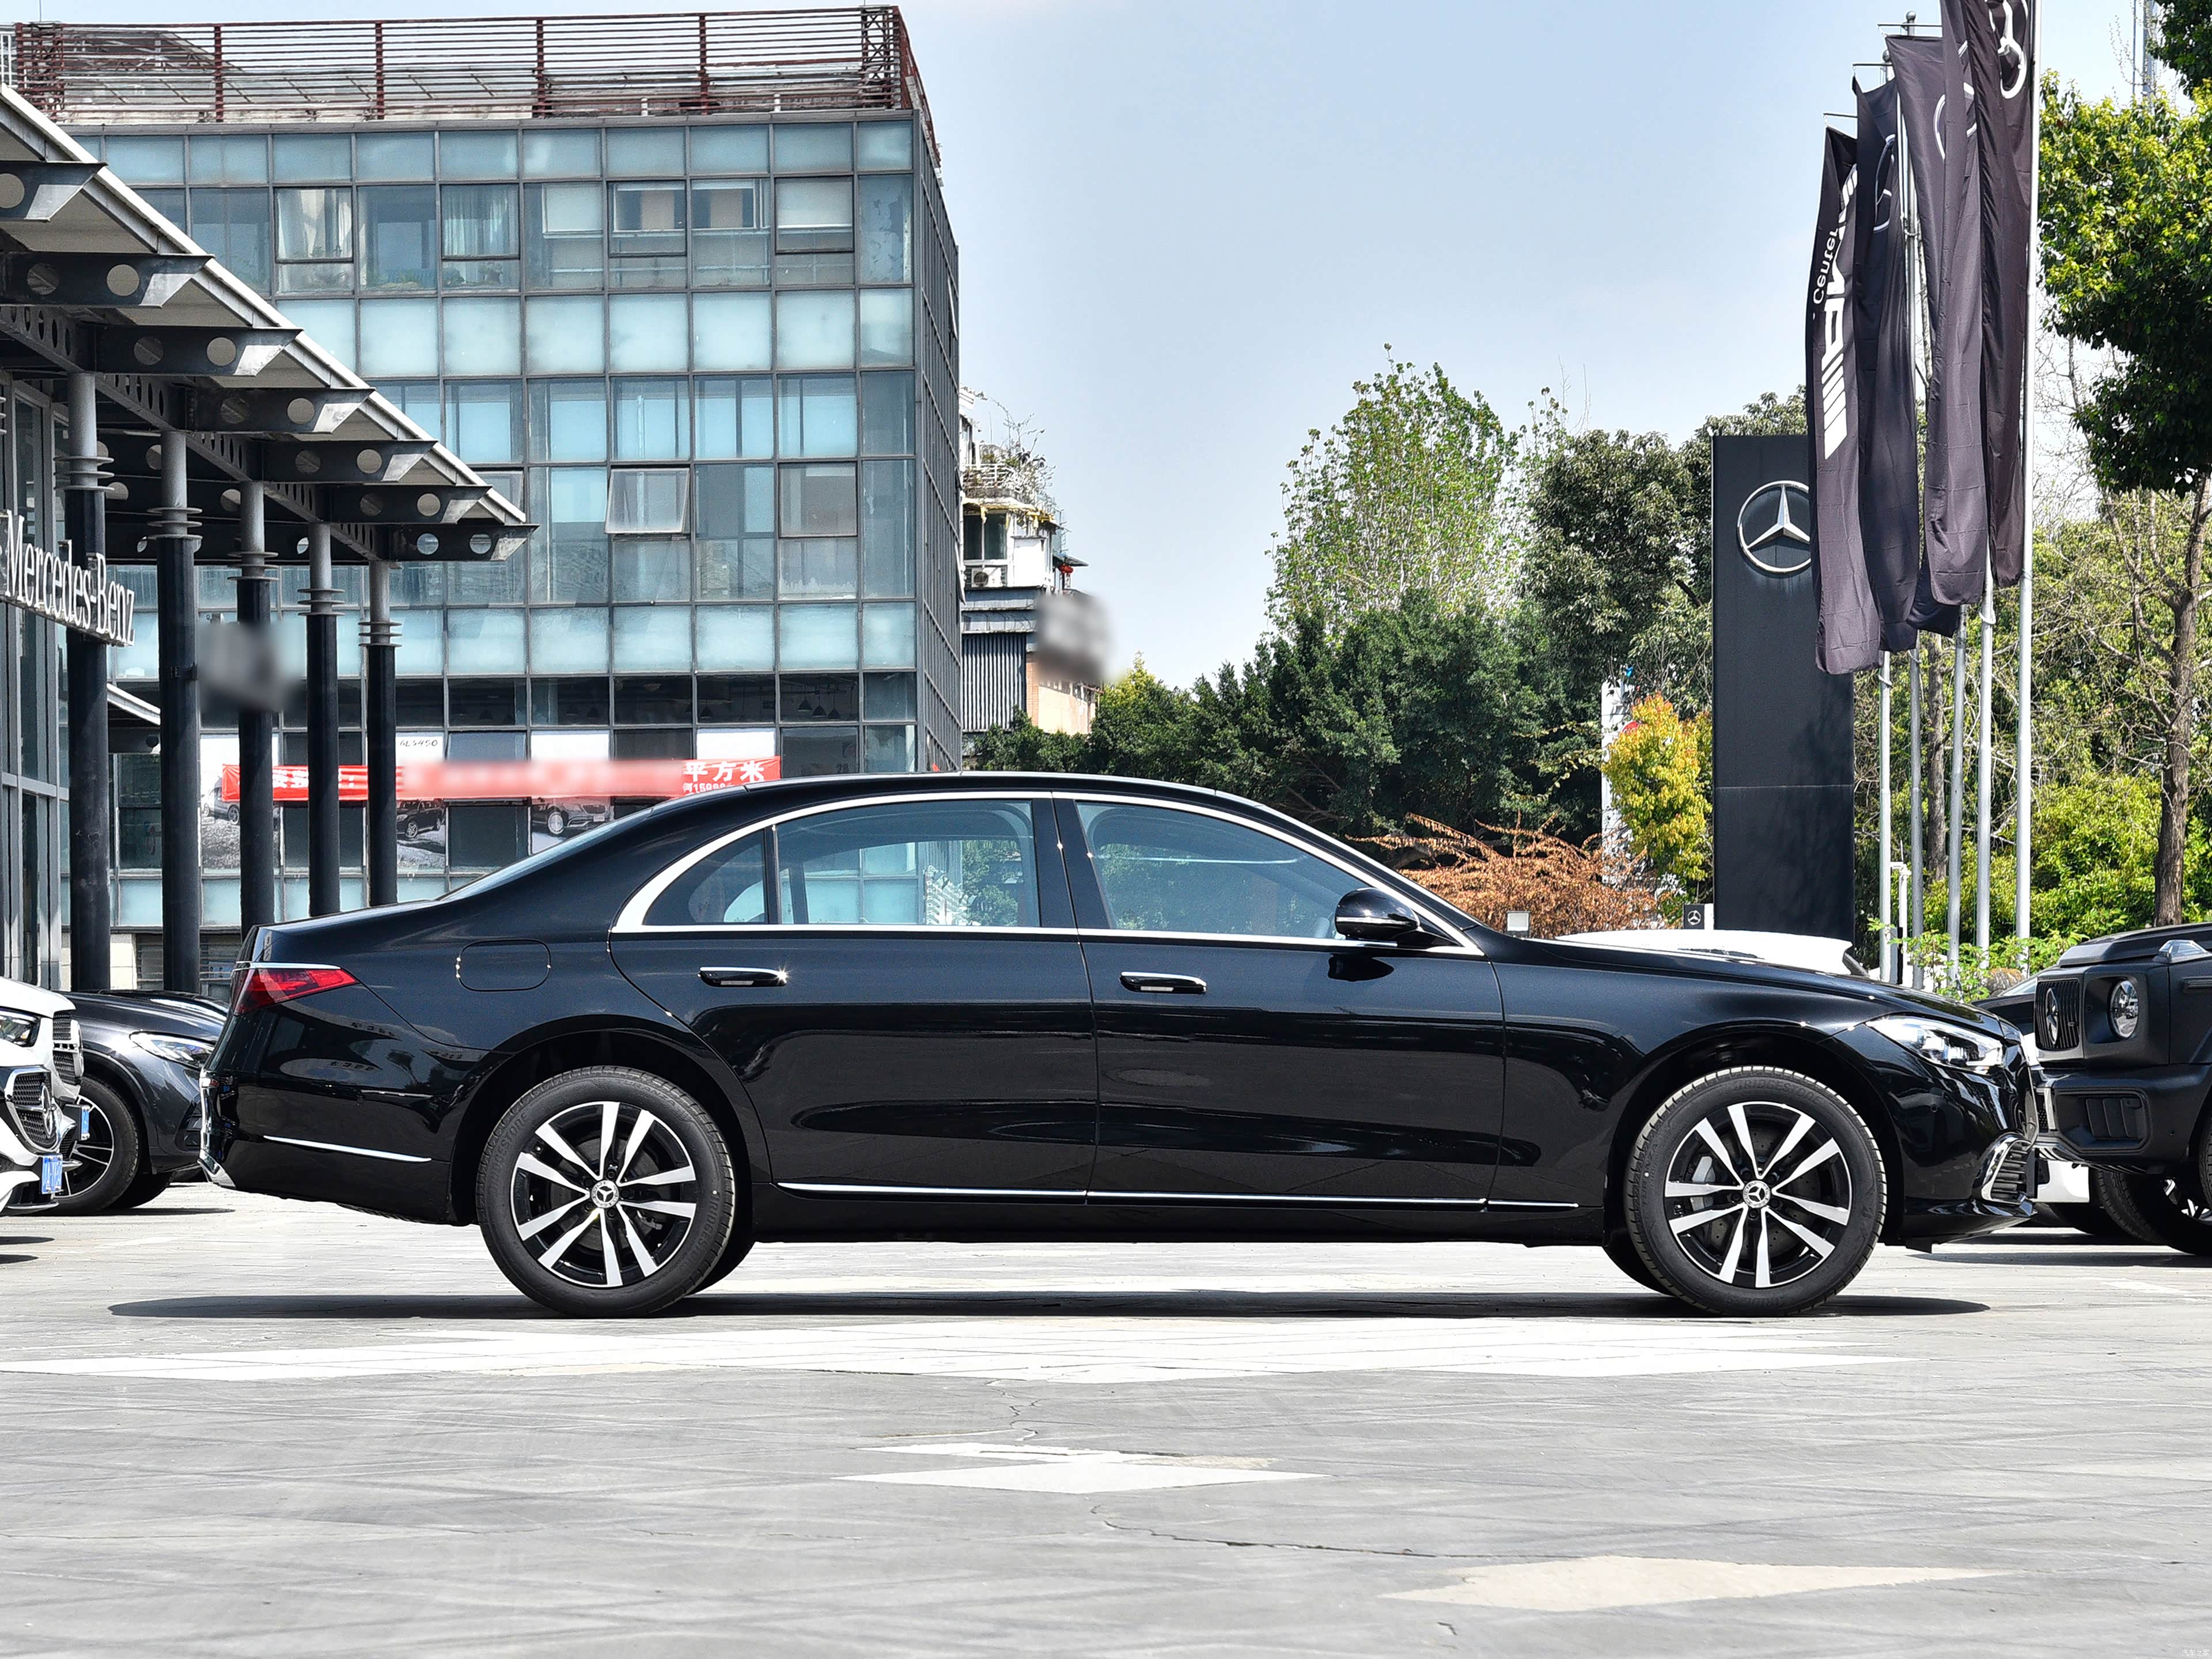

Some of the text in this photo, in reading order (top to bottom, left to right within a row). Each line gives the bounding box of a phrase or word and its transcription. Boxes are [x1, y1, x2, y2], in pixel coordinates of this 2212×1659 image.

[5, 509, 135, 646] Mercedes-Benz
[683, 760, 765, 783] 平方米
